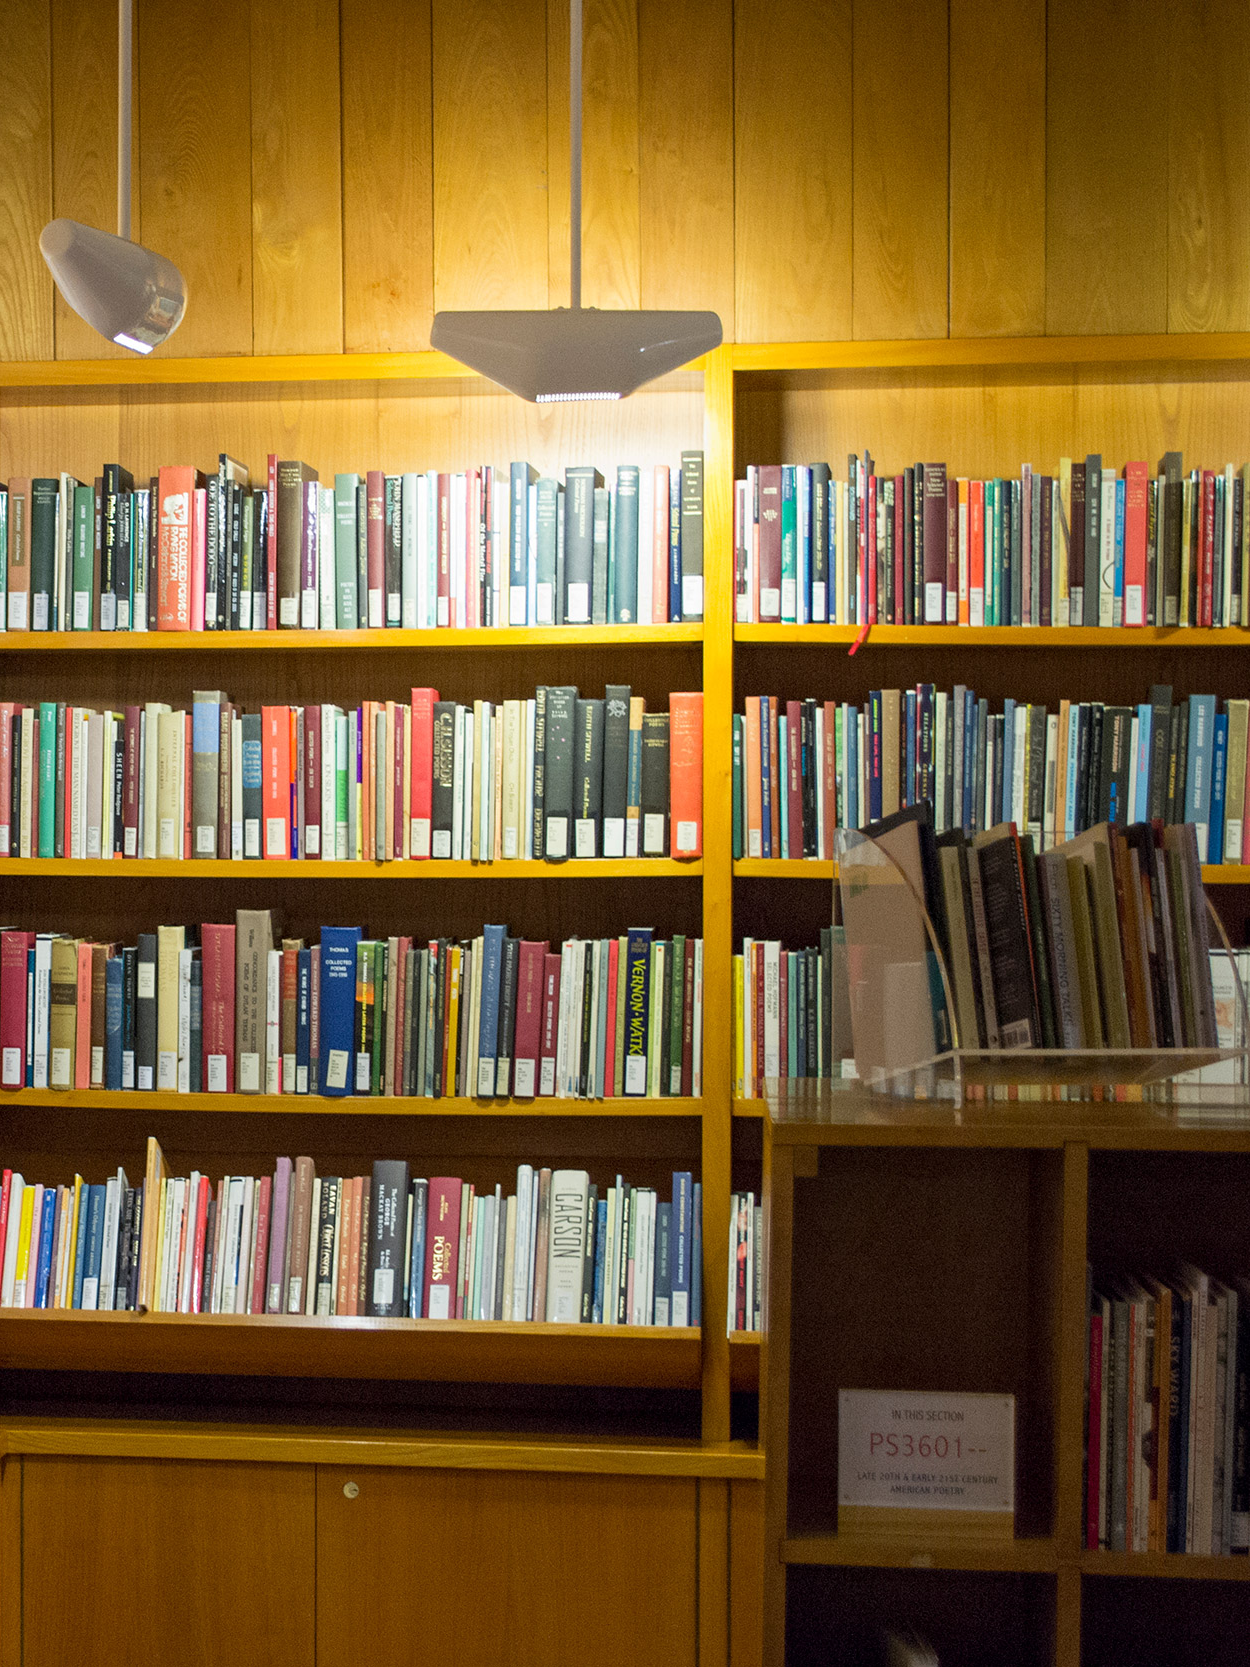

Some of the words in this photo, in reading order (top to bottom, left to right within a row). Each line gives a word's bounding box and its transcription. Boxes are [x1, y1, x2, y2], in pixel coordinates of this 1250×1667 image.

[209, 502, 216, 515] TO
[161, 527, 170, 571] McClelland
[170, 527, 178, 553] IRVING
[170, 553, 178, 581] LAYTON
[178, 536, 187, 582] COLLECTED
[160, 578, 168, 606] Stewart
[178, 582, 187, 610] POEMS
[178, 611, 186, 622] OF
[440, 740, 452, 787] SISSON
[1052, 898, 1061, 928] SIXTY
[1055, 932, 1068, 988] MORNING
[243, 984, 249, 992] OF
[630, 959, 646, 1012] VERNON
[320, 1224, 334, 1248] Object
[554, 1194, 583, 1259] CARSON
[320, 1250, 332, 1276] Lessons
[432, 1236, 445, 1280] POEMS
[1171, 1337, 1180, 1363] SKY
[1170, 1369, 1180, 1416] WARD
[892, 1410, 900, 1420] IN
[904, 1410, 924, 1420] THIS
[926, 1410, 964, 1422] SECTION
[858, 1472, 876, 1481] LATE
[912, 1474, 936, 1482] EARLY
[962, 1475, 998, 1485] CENTURY
[890, 1485, 930, 1494] AMERICAN
[934, 1486, 964, 1496] POETRY
